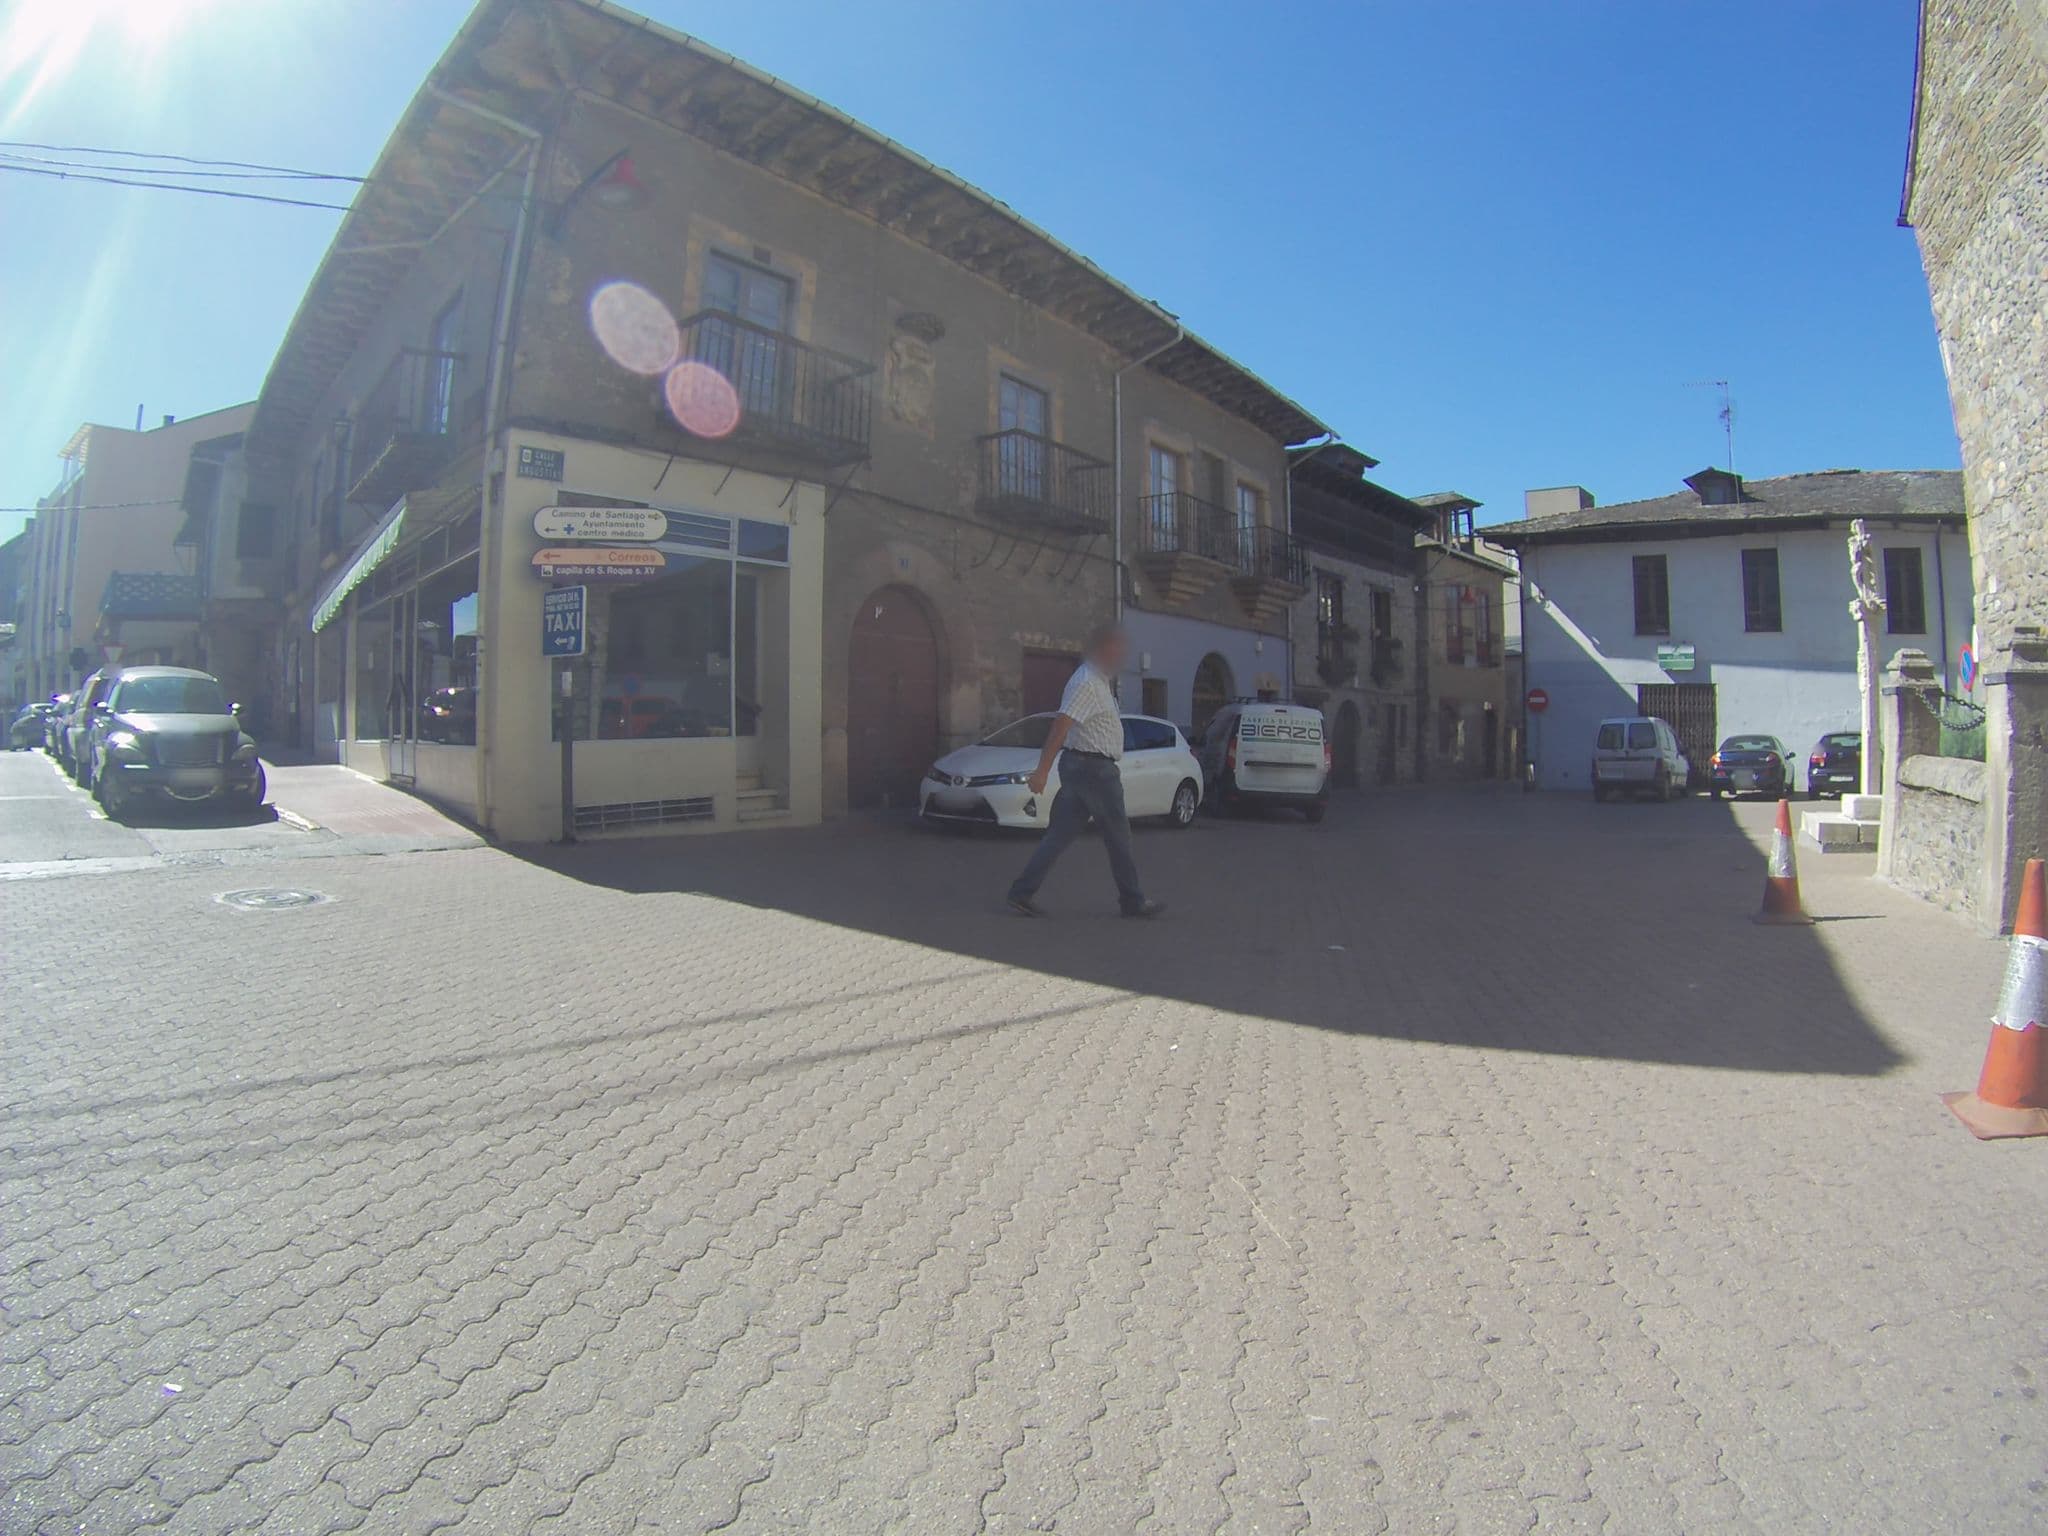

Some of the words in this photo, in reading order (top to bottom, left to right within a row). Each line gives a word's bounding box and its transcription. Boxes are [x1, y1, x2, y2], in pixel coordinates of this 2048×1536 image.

[551, 509, 586, 518] Camino
[589, 510, 601, 518] de
[605, 510, 646, 520] Santiago
[582, 519, 645, 529] Ayuntamiento
[577, 528, 607, 537] centro
[608, 551, 656, 562] Correos
[555, 566, 583, 576] capilla
[584, 566, 596, 575] de
[596, 566, 606, 575] S.
[606, 566, 633, 576] Roque
[643, 566, 656, 575] XV
[545, 611, 580, 632] TAXI
[1241, 724, 1321, 740] BIERZO
